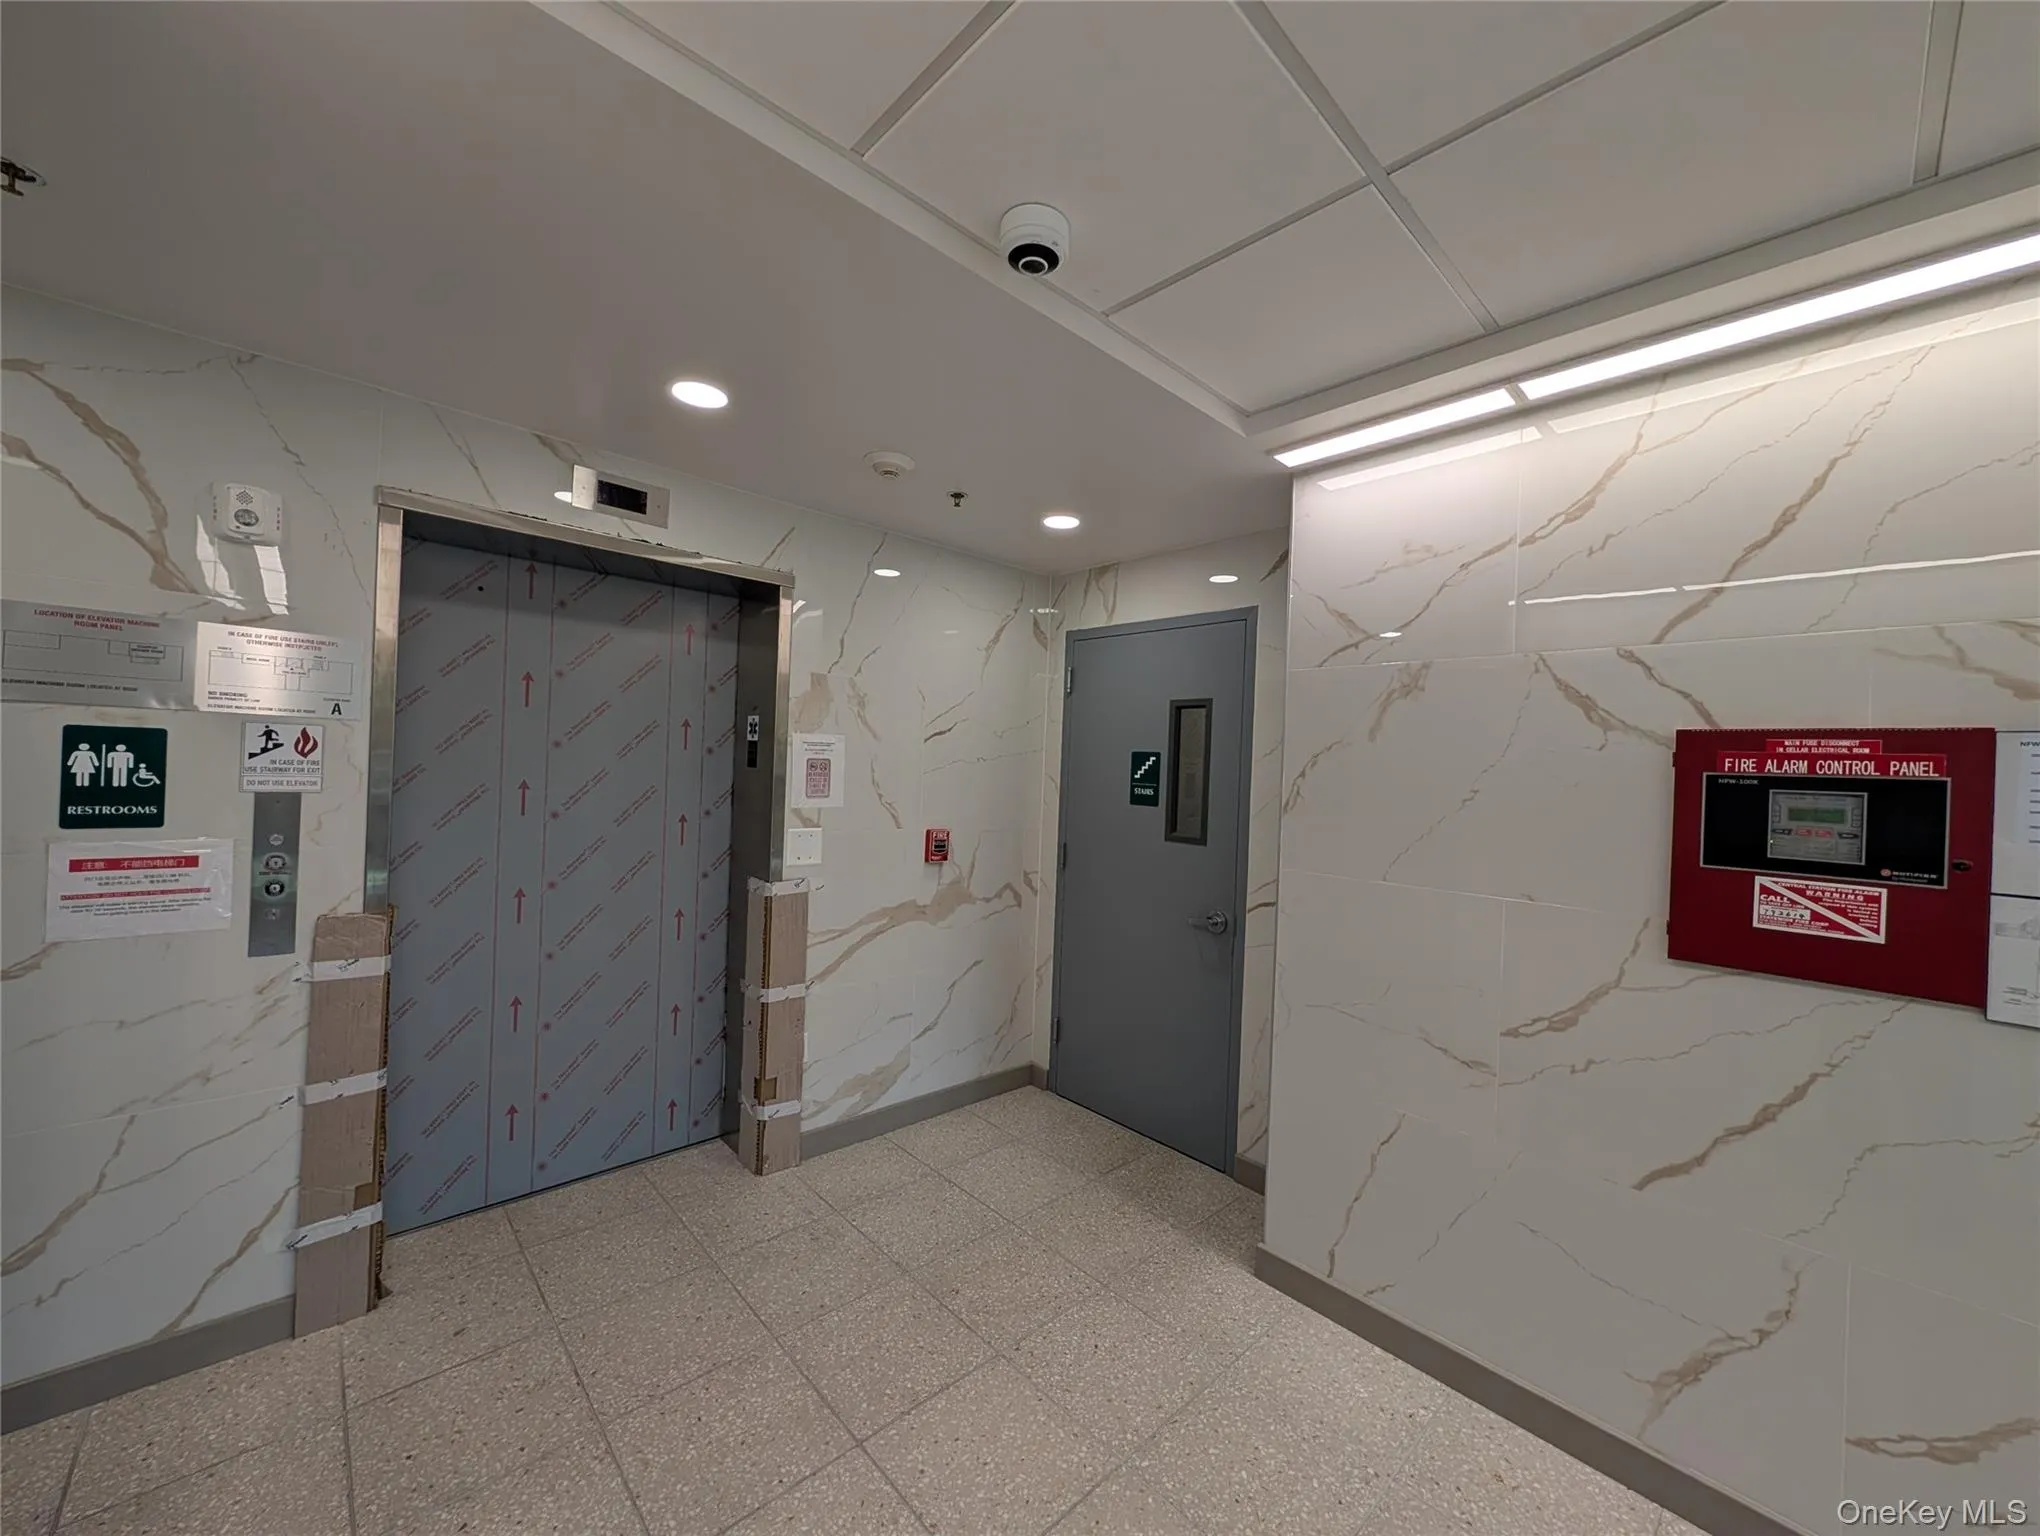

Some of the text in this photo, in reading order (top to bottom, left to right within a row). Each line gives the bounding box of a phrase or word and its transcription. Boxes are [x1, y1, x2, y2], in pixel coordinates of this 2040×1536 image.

[34, 609, 74, 619] LOCATION
[87, 613, 125, 624] ELEVATOR
[127, 618, 160, 628] MACHINE
[73, 620, 124, 631] ROOM PANEL
[331, 703, 342, 715] A
[1724, 759, 1939, 777] FIRE ALARM CONTROL PANEL
[67, 804, 157, 815] RESTROOMS
[933, 831, 948, 839] FIRE
[1760, 894, 1790, 903] CALL
[1805, 890, 1864, 901] WARNING
